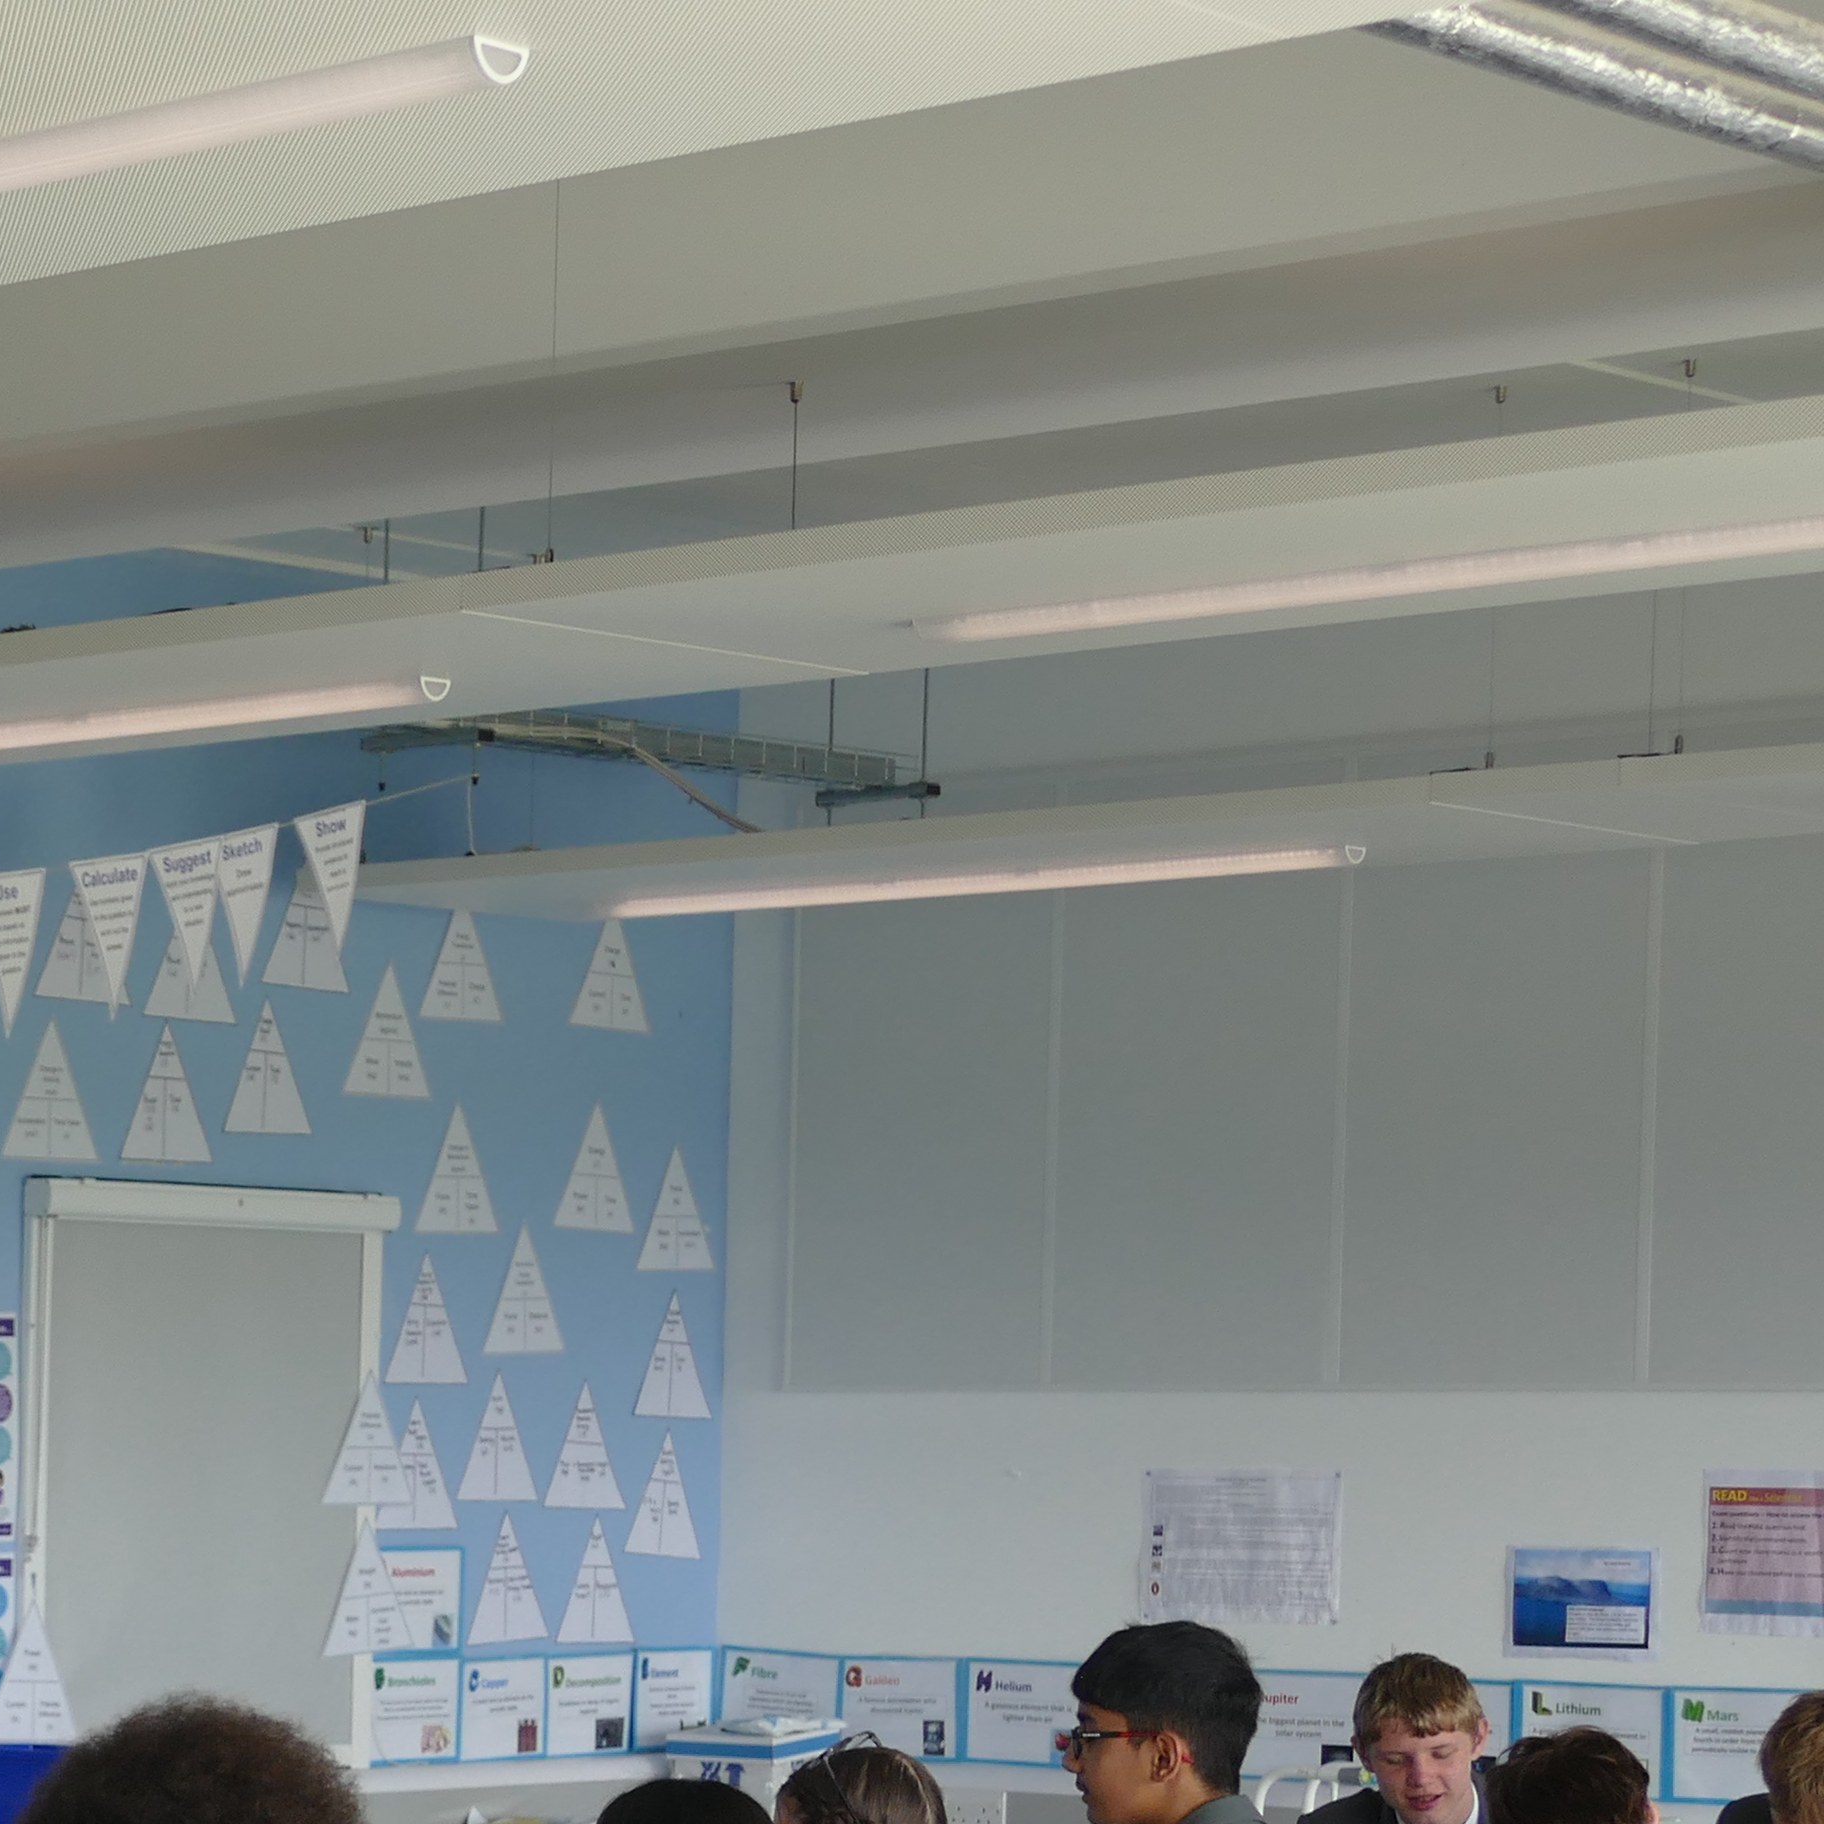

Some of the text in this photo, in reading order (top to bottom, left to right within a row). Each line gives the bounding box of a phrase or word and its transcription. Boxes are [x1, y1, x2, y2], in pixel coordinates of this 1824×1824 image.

[315, 818, 346, 837] Show
[222, 838, 263, 861] Sketch
[163, 850, 212, 874] Suggest
[81, 867, 138, 888] Calculate
[1712, 1489, 1749, 1501] READ
[391, 1566, 436, 1578] Aluminium
[481, 1677, 509, 1689] Copper
[864, 1676, 900, 1686] Galileo
[994, 1680, 1032, 1693] Helium
[1556, 1703, 1601, 1717] Lithium
[1706, 1710, 1739, 1722] Mars
